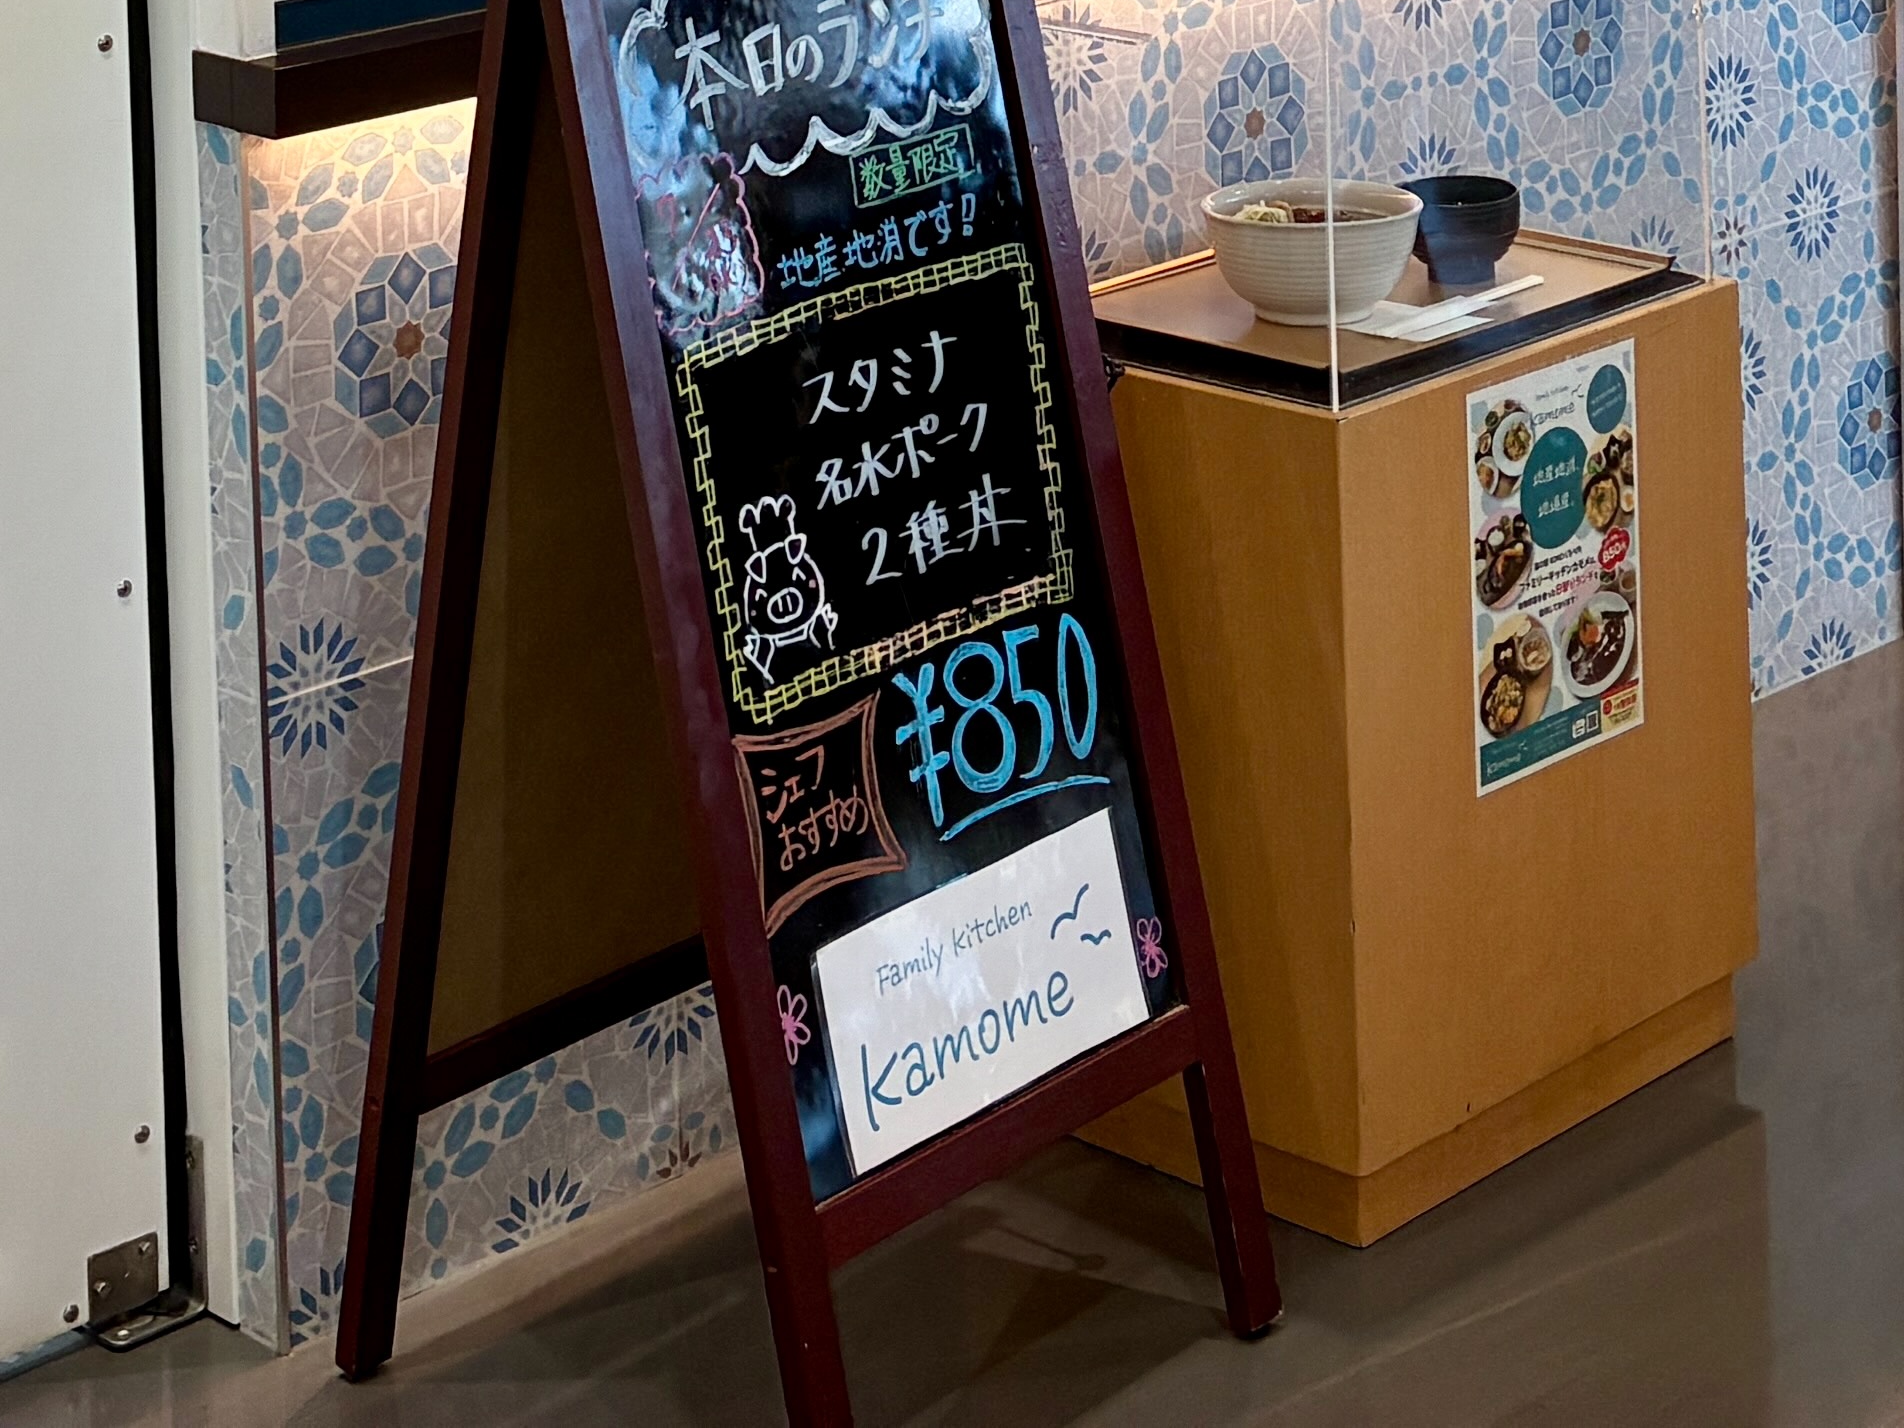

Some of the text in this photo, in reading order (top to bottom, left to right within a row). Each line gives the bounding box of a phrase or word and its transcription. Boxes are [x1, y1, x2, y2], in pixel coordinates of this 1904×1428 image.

[859, 135, 967, 199] 数量限定
[802, 328, 959, 425] スタミナ
[815, 402, 989, 513] 名水ポーク
[862, 474, 1028, 587] 2種丼
[892, 613, 1099, 827] ¥850
[759, 746, 824, 824] シェフ
[778, 789, 870, 873] おすすめ
[876, 898, 1033, 998] Family kitchen
[861, 970, 1075, 1131] kamome
